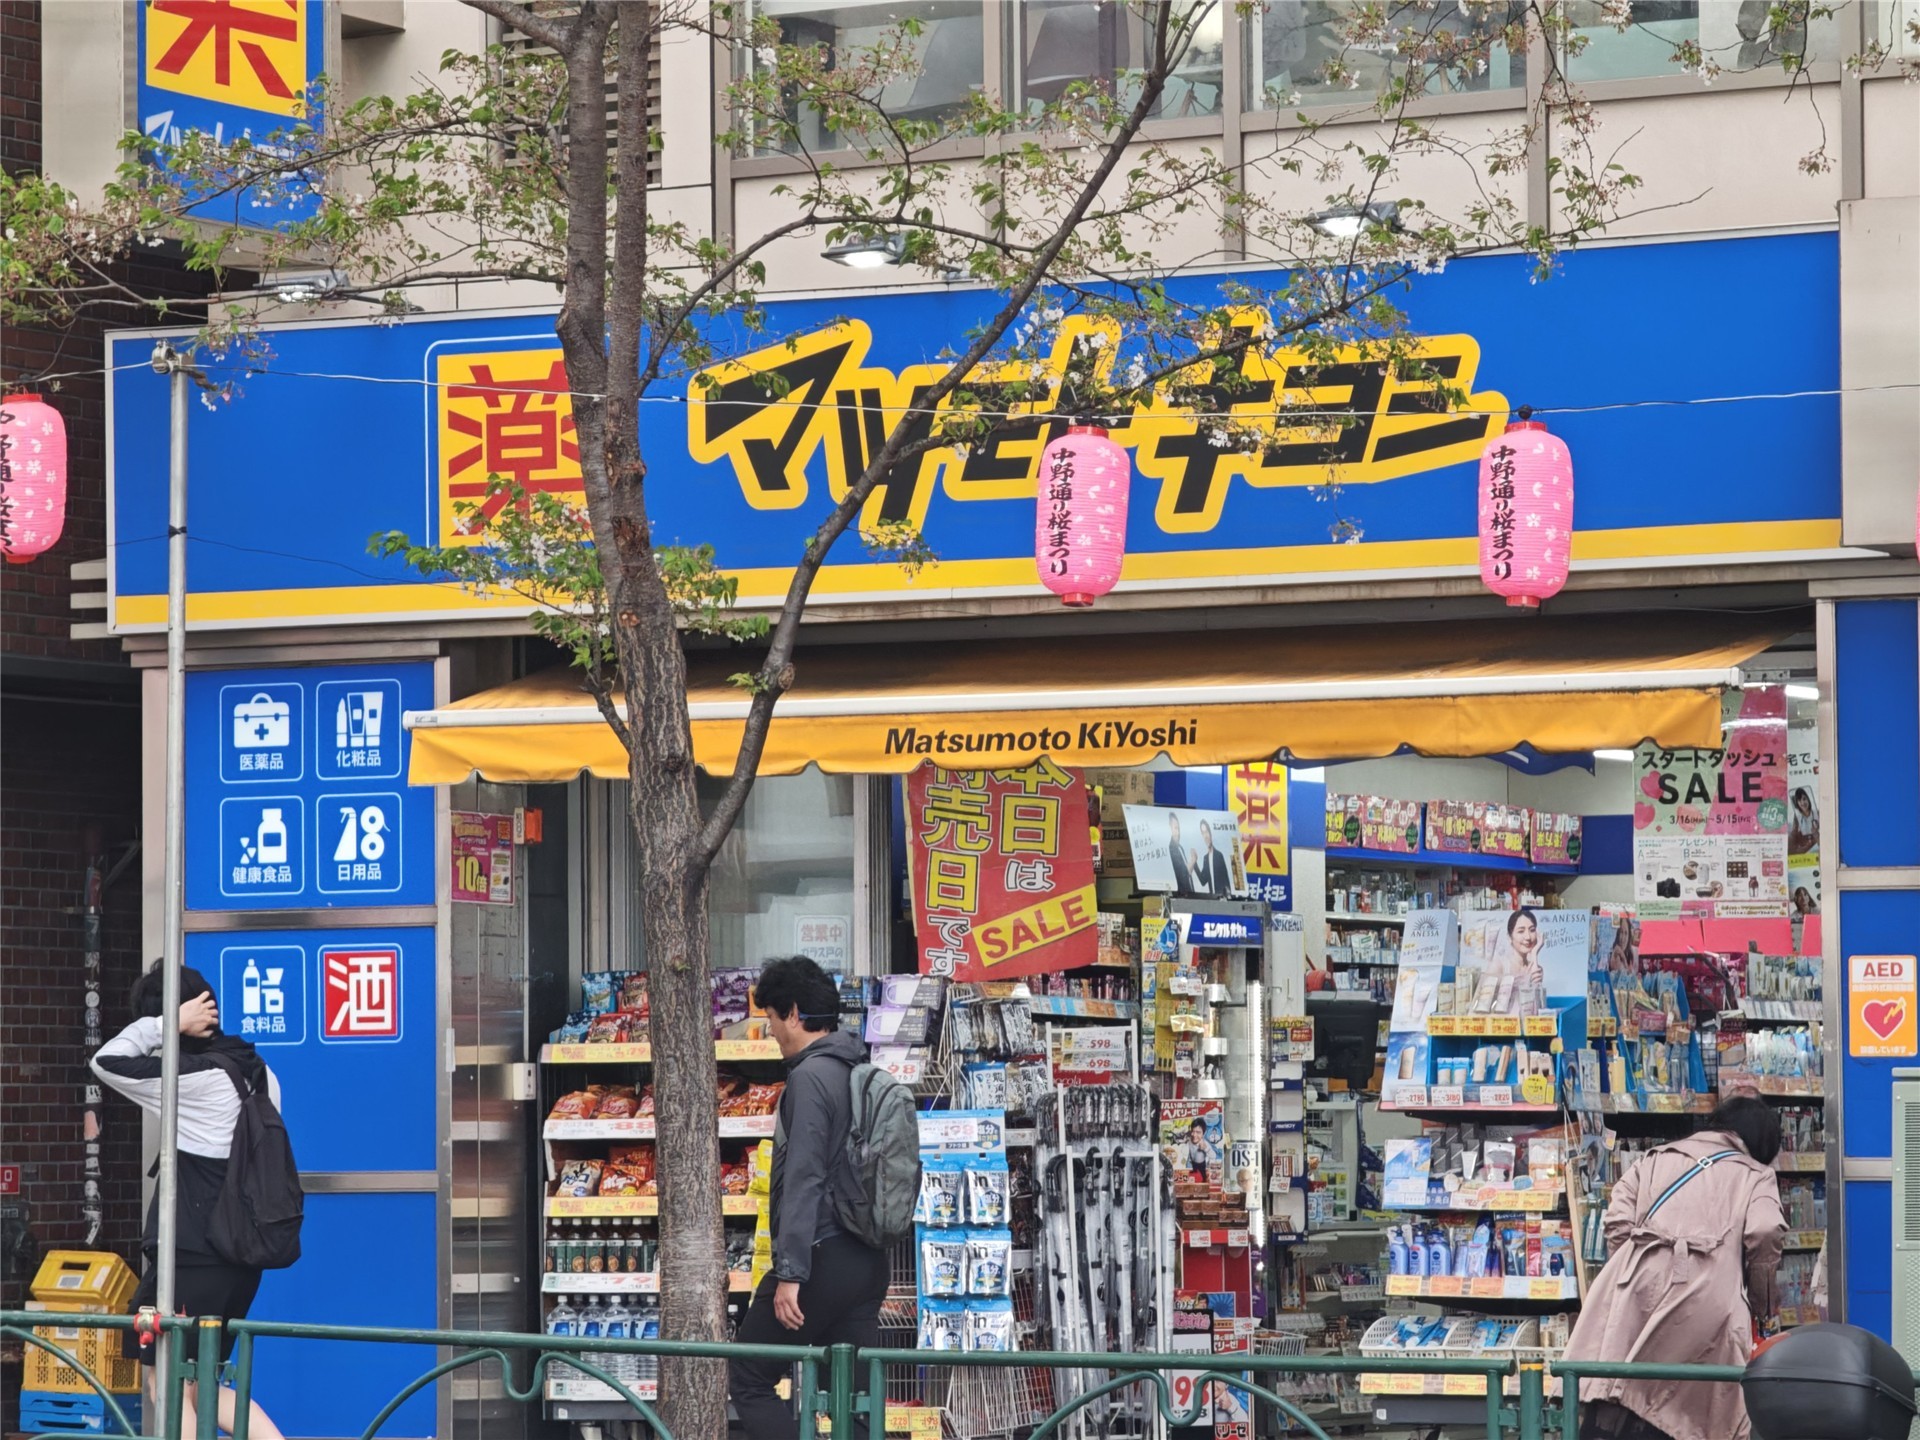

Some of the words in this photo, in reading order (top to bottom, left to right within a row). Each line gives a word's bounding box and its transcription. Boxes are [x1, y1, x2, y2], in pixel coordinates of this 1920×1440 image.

[446, 359, 588, 537] 薬
[1048, 446, 1077, 577] 中野通り桜まつり
[1489, 444, 1517, 580] 中野通り桜まつり
[885, 726, 1071, 755] Matsumoto
[1077, 718, 1198, 749] KiYoshi
[239, 753, 284, 772] 医薬品
[335, 750, 381, 768] 化粧品
[1641, 749, 1778, 769] スタートダッシュ
[1658, 772, 1764, 804] SALE
[990, 755, 1075, 893] 本日は
[1235, 760, 1281, 869] 薬
[232, 865, 292, 884] 健康食品
[338, 863, 382, 881] 日用品
[980, 894, 1091, 960] SALE
[1551, 914, 1587, 923] ANESSA
[800, 923, 843, 942] 営業中
[1411, 930, 1440, 938] ANESSA
[1863, 962, 1904, 977] AED
[329, 957, 393, 1032] 酒
[241, 1016, 286, 1033] 食料品
[1090, 1039, 1111, 1049] 598
[1089, 1058, 1111, 1068] 698
[1231, 1149, 1259, 1168] OS-1
[929, 1243, 945, 1258] in
[973, 1243, 989, 1259] in
[934, 1312, 950, 1329] in
[973, 1312, 988, 1329] in
